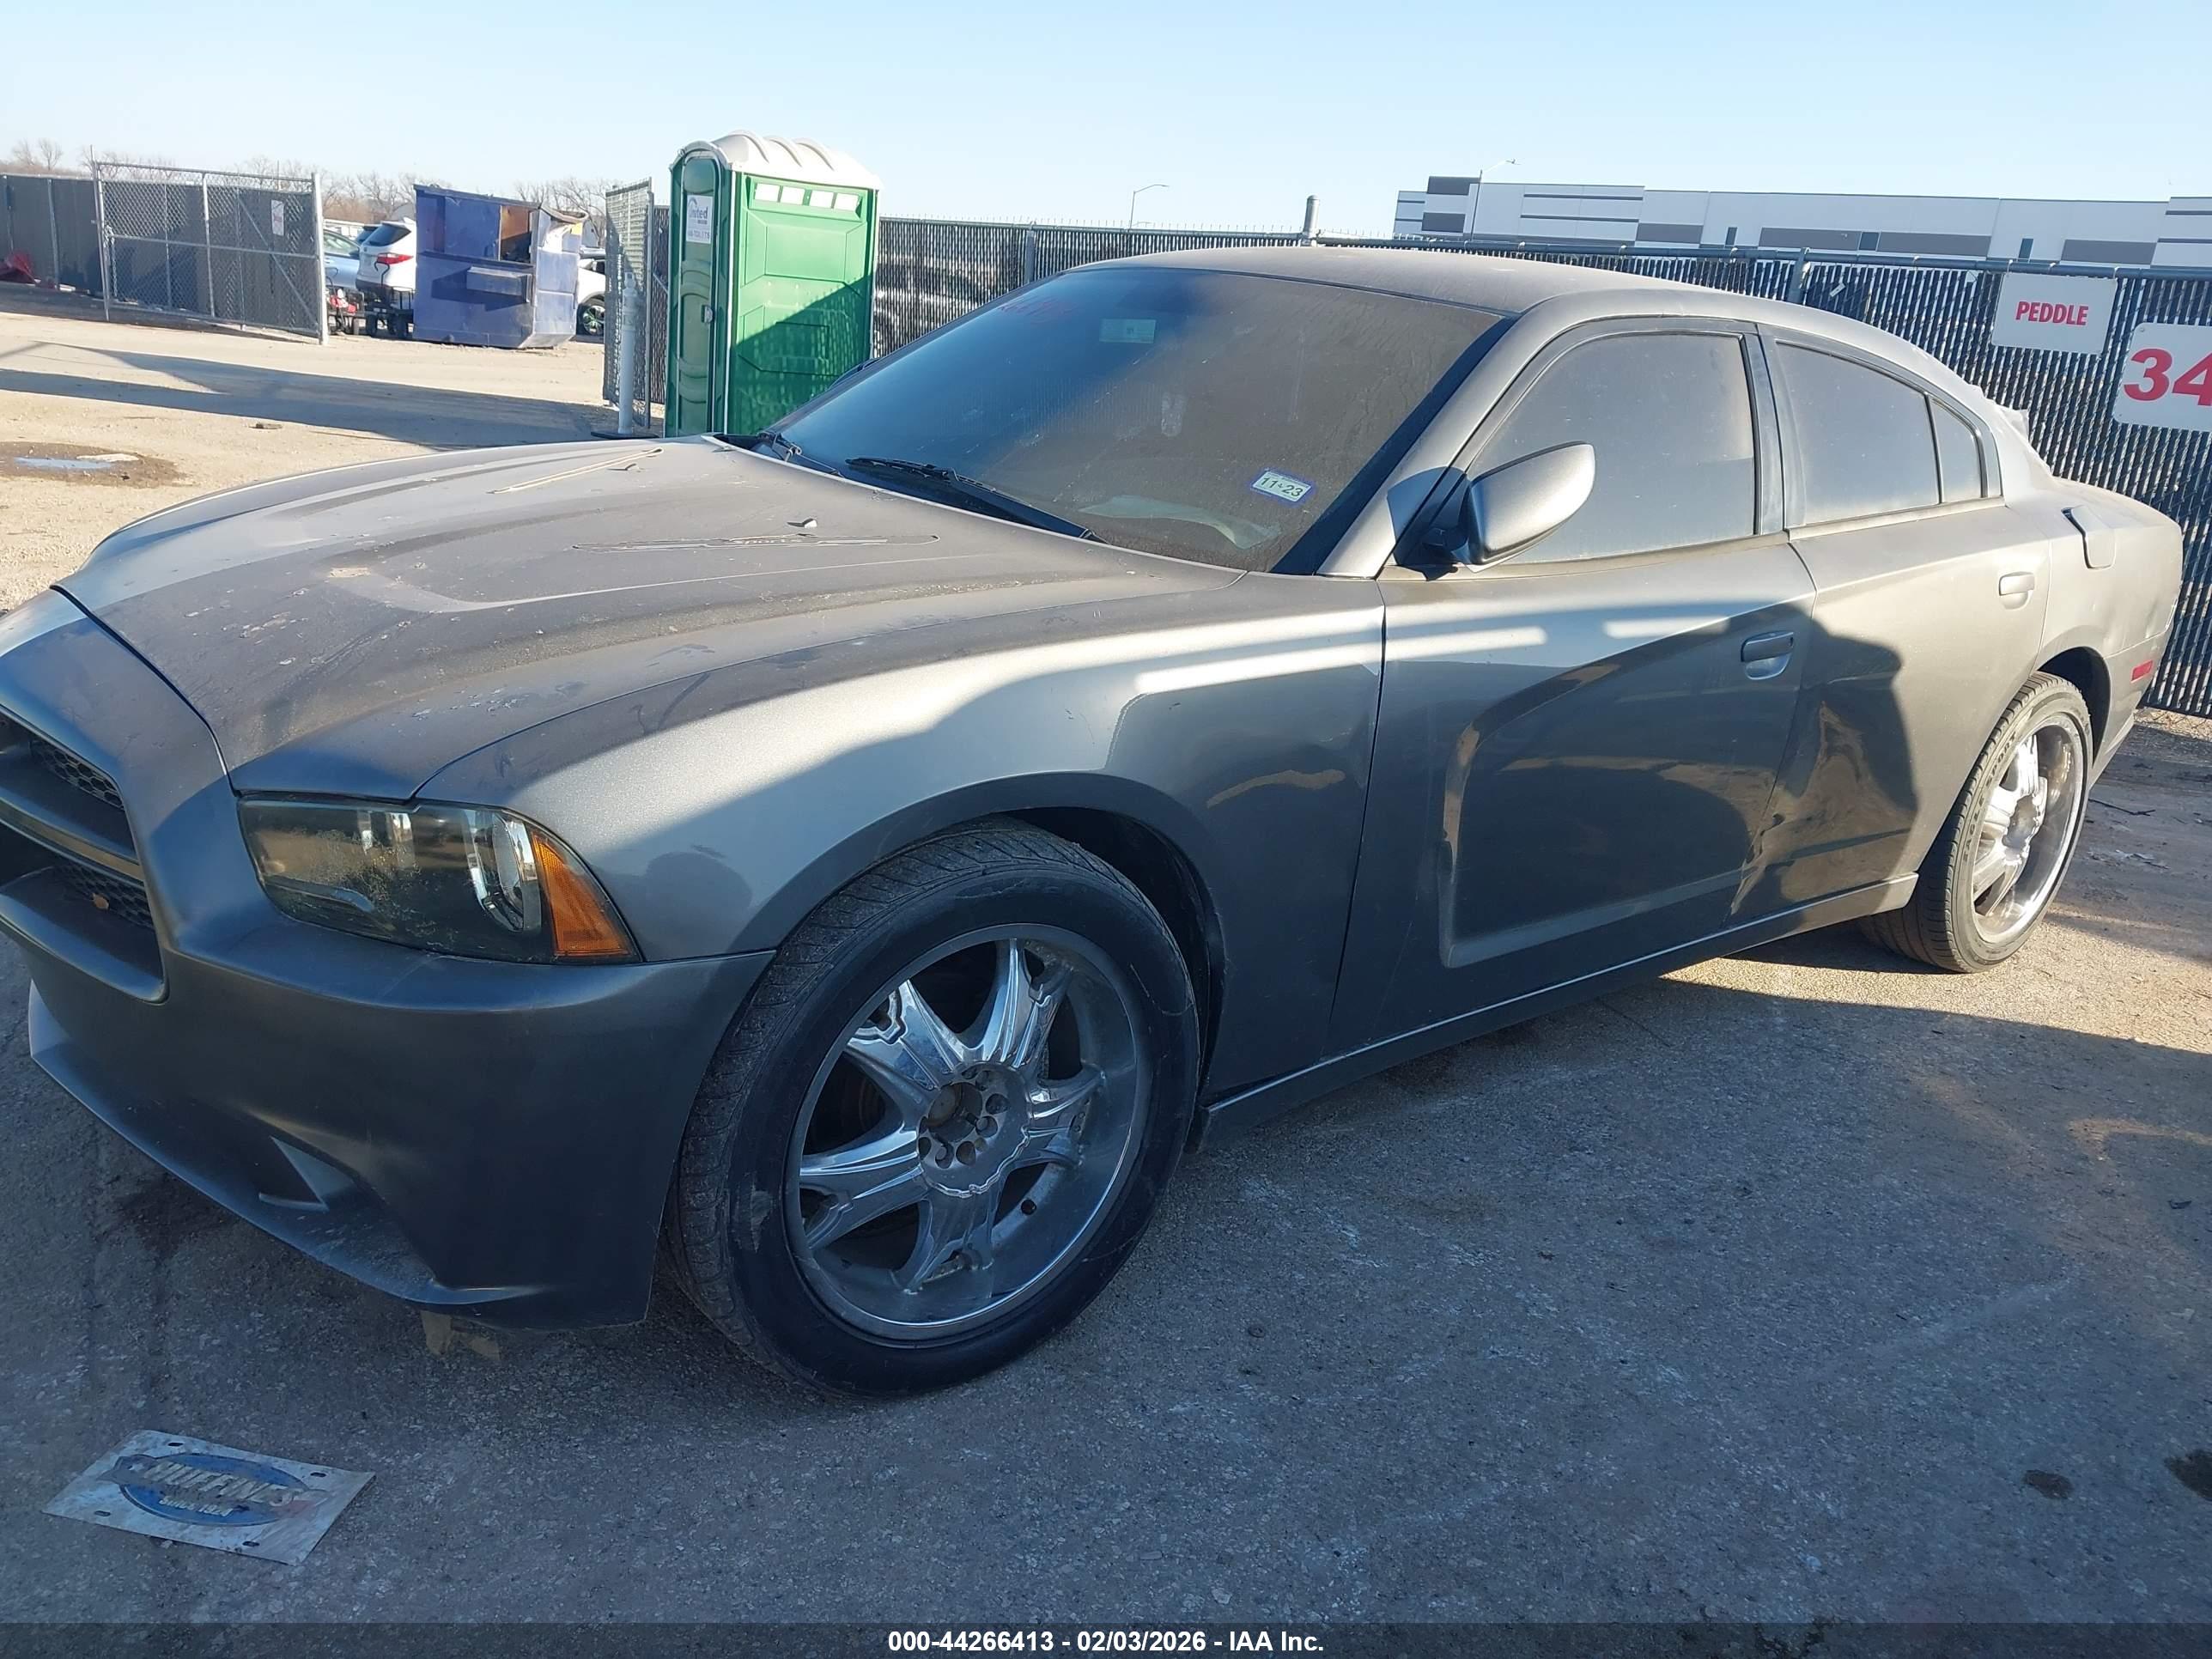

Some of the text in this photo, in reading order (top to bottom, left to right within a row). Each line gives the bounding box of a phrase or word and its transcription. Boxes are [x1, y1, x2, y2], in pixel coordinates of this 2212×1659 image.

[2016, 301, 2088, 325] PEDDLE
[2124, 348, 2212, 406] 34
[1964, 732, 2016, 862] EAGLE SPORT
